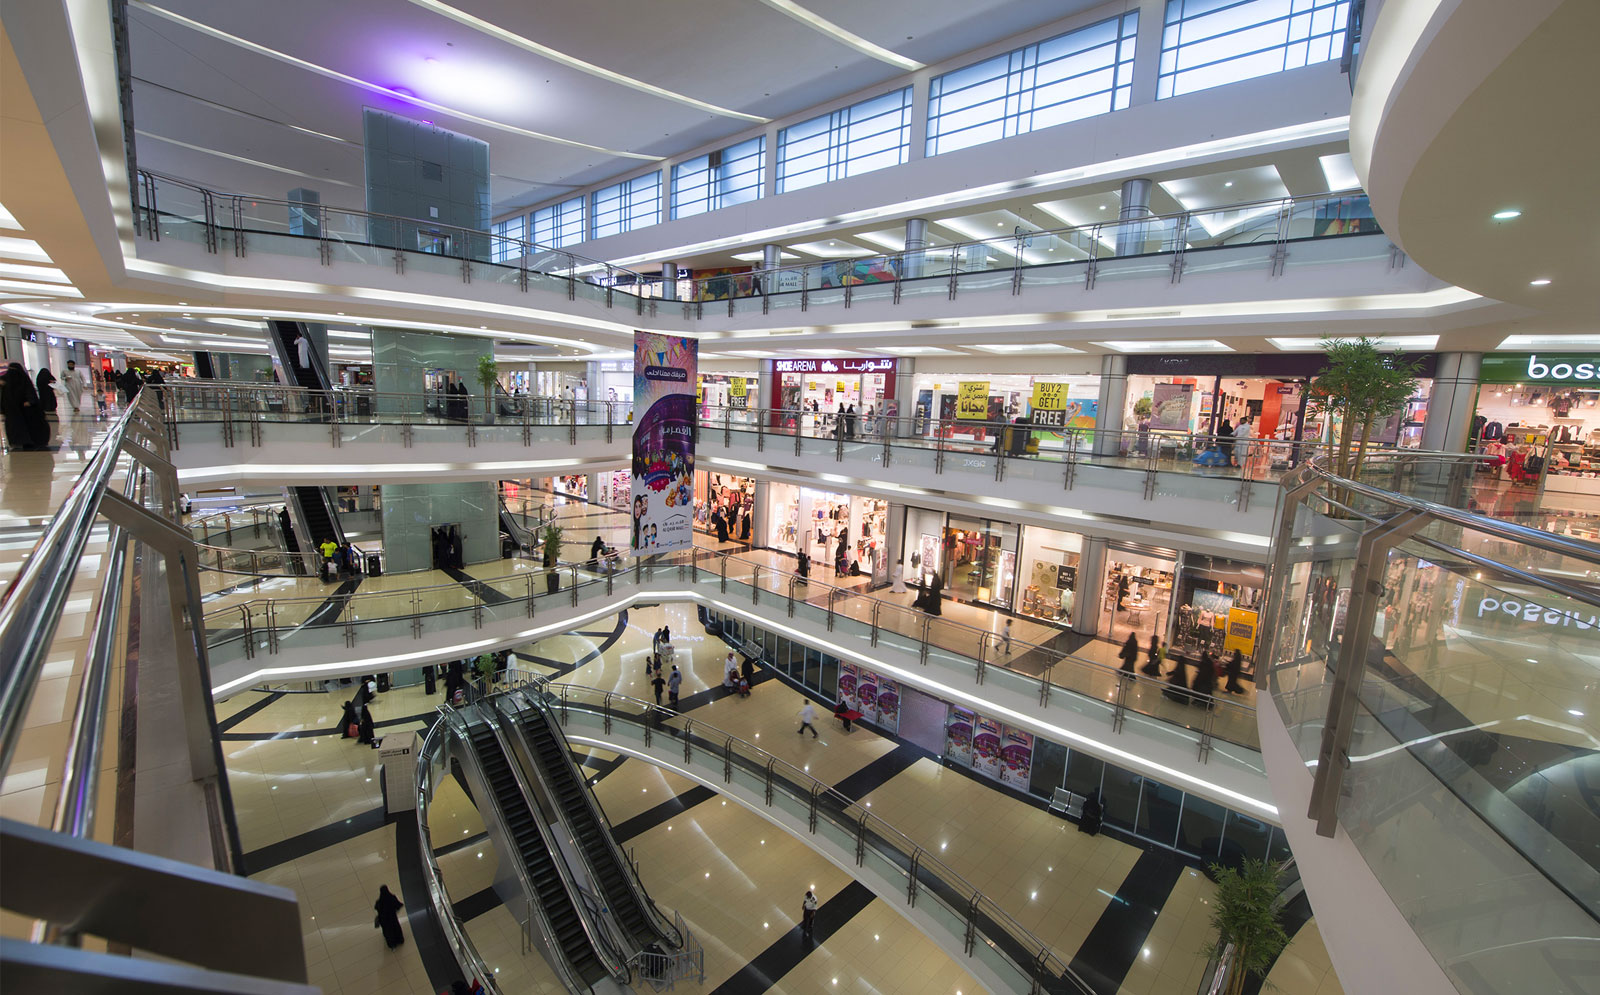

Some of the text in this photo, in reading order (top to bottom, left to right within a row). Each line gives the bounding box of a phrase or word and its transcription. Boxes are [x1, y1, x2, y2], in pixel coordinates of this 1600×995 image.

[776, 360, 817, 372] SHOE ARENA
[843, 359, 893, 373] شوارينا
[1527, 354, 1600, 380] bos
[1040, 383, 1062, 393] BUY 2
[731, 396, 745, 407] FREE
[1038, 397, 1060, 408] GET 1
[1033, 410, 1062, 426] FREE
